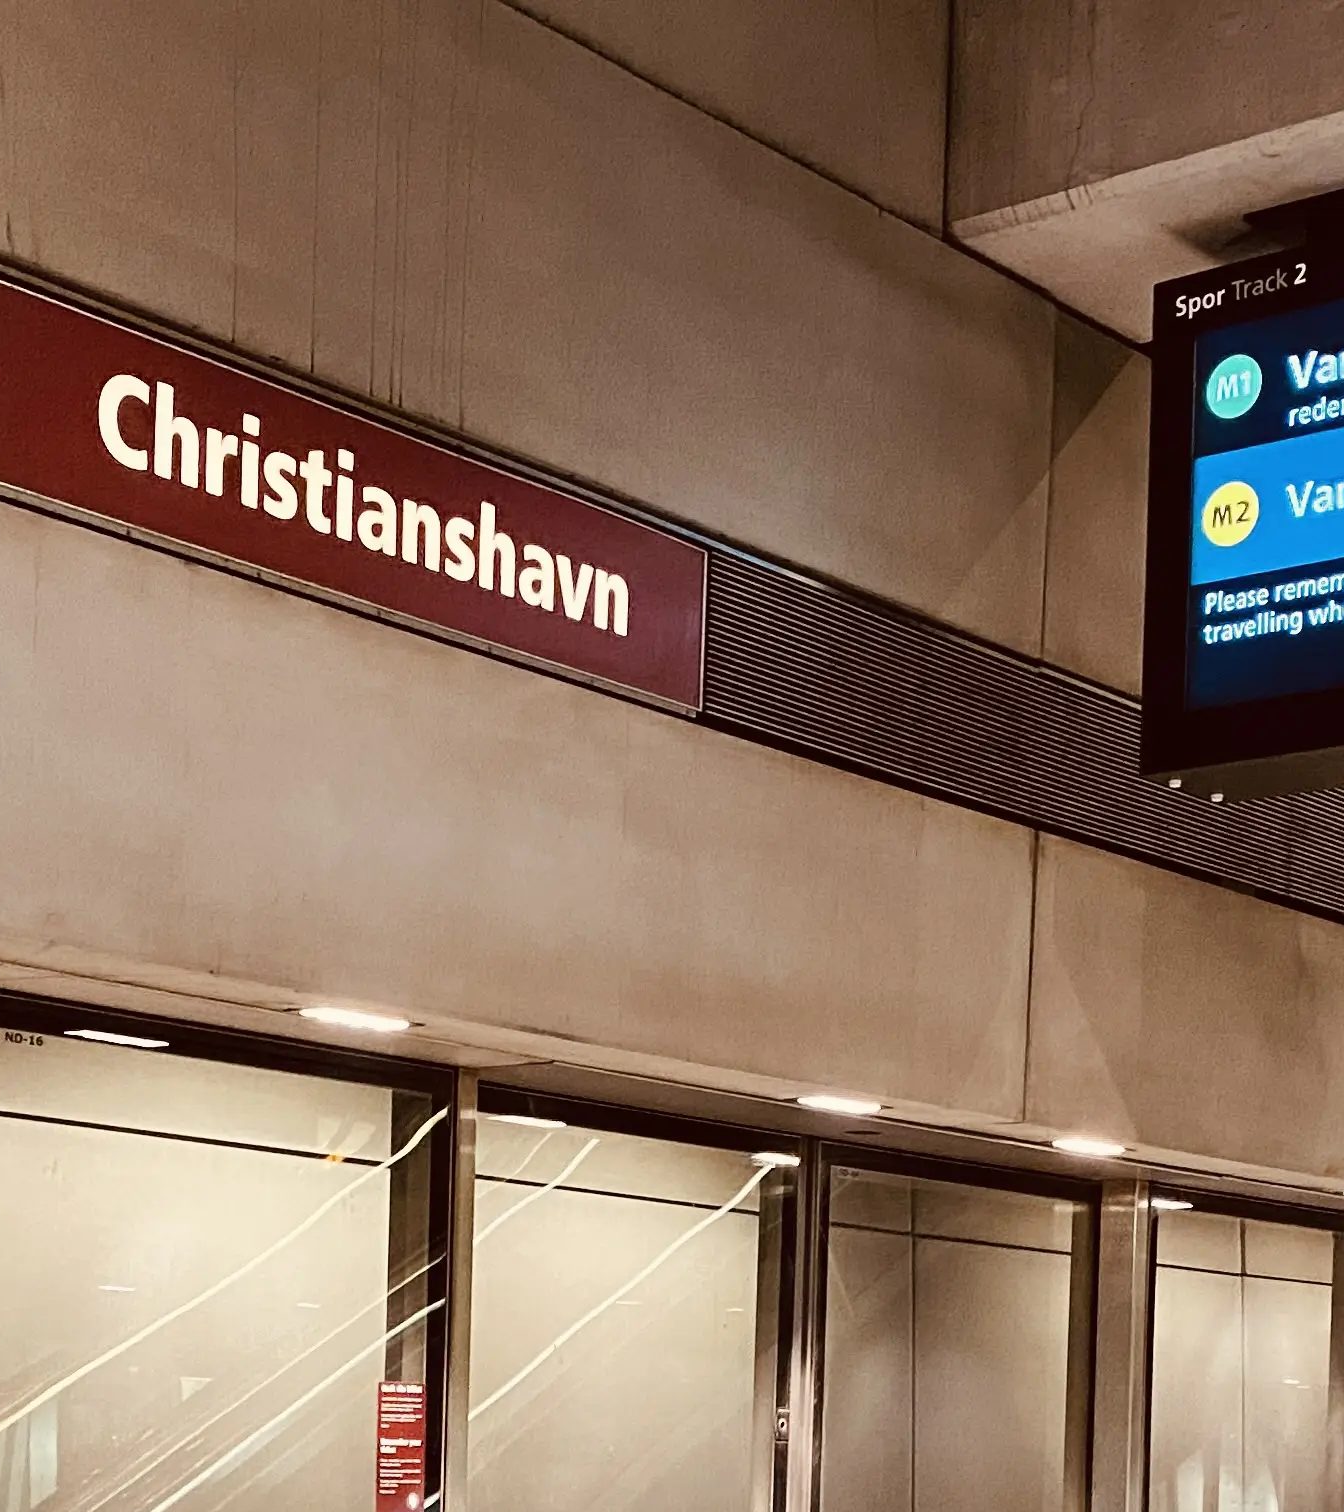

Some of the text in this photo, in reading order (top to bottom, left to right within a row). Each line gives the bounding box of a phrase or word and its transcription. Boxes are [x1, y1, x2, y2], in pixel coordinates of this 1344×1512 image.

[1175, 263, 1307, 319] Spor Track 2
[1216, 370, 1252, 401] M1
[96, 373, 630, 638] Christianshavn
[1212, 500, 1251, 529] M2
[1205, 588, 1269, 615] Please
[1203, 609, 1303, 644] travelling
[4, 1031, 44, 1047] ND-16
